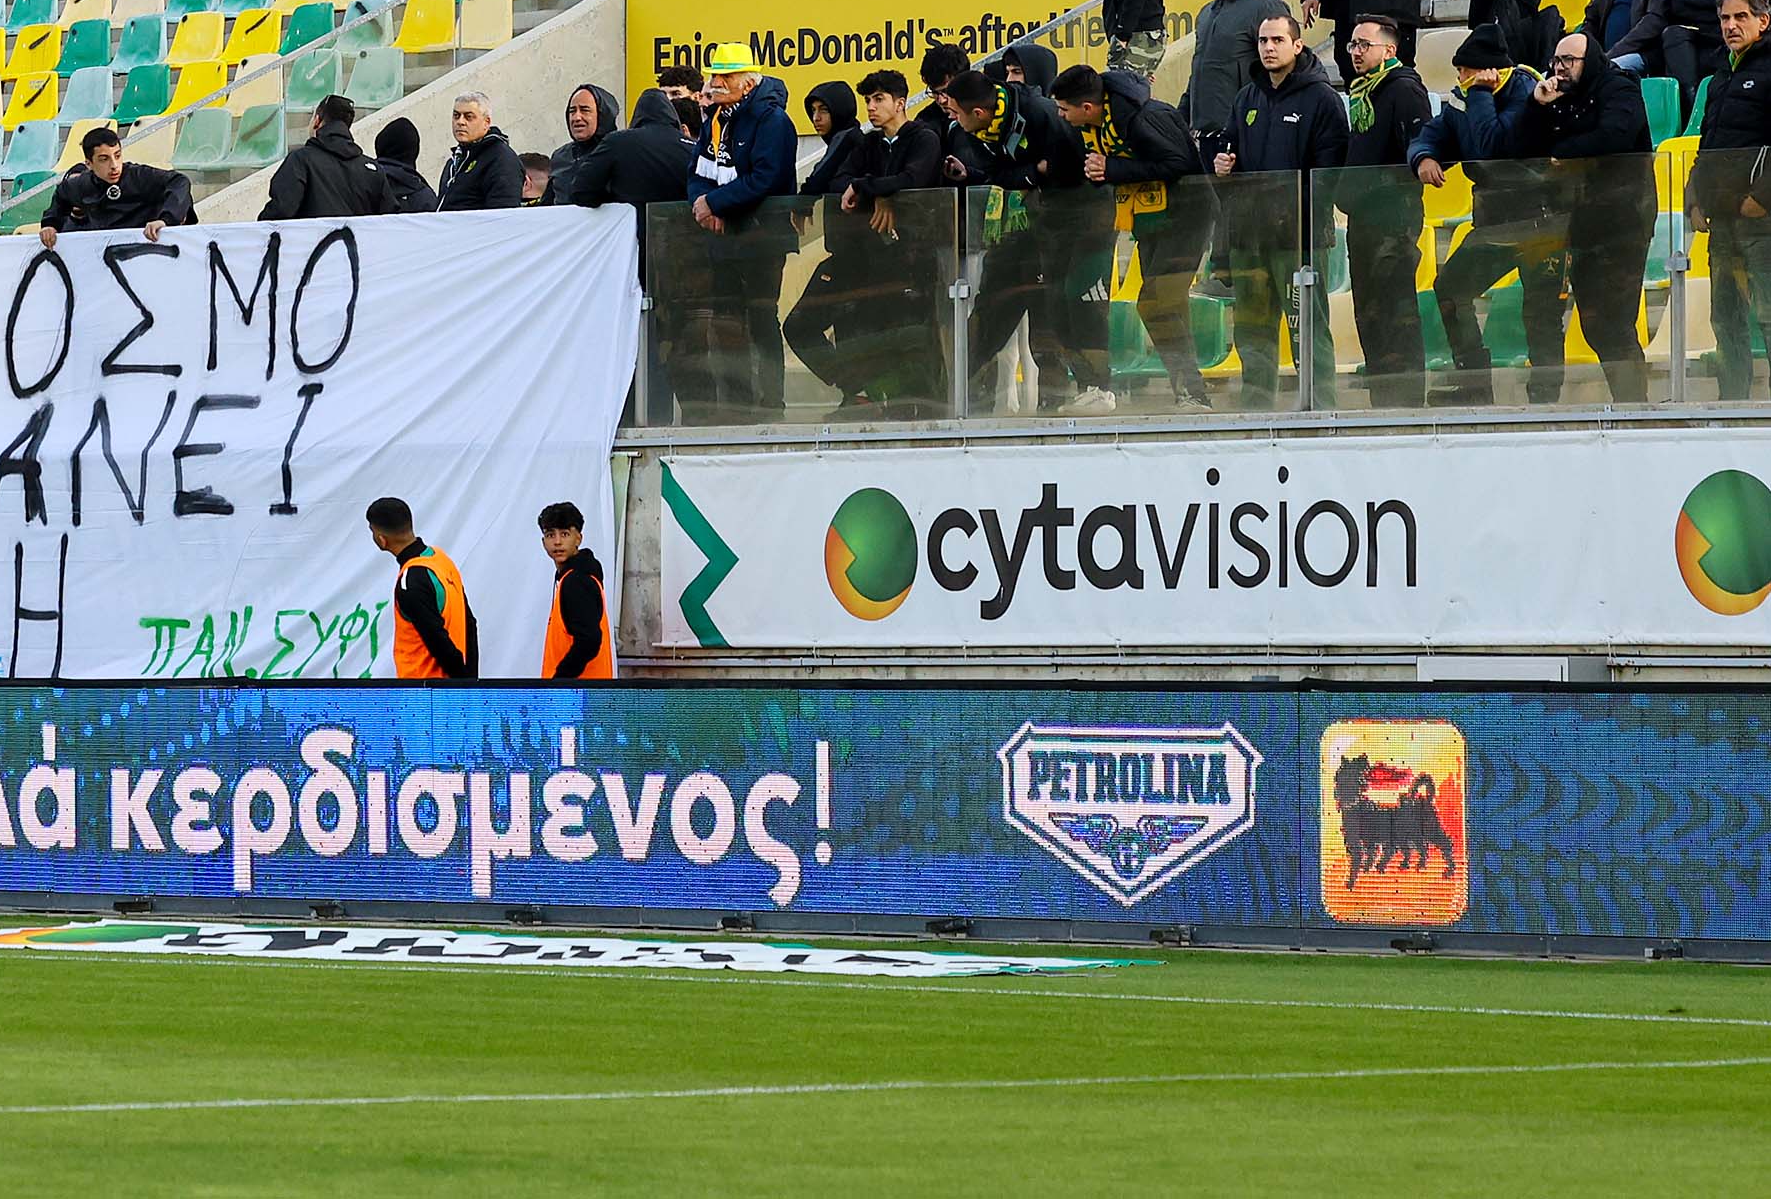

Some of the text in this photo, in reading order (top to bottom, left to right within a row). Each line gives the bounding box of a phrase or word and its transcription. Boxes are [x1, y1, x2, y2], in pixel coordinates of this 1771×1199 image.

[927, 468, 1417, 620] cytavision
[110, 726, 832, 907] κερδισμένος!
[1028, 750, 1231, 805] PETROLINA
